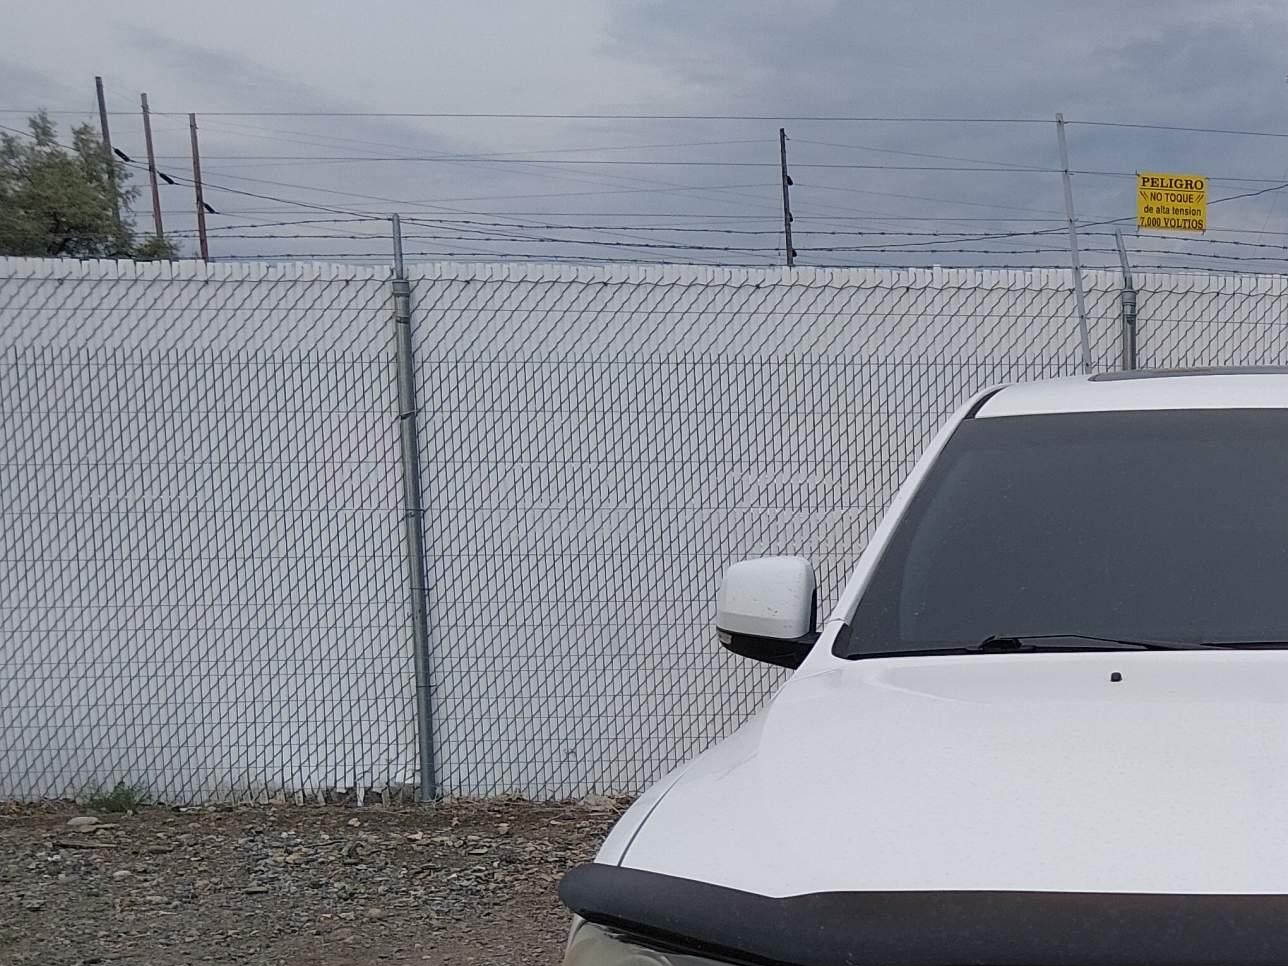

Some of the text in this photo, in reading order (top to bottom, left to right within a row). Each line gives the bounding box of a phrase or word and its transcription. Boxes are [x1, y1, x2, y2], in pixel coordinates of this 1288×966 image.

[1142, 177, 1204, 190] PELIGRO
[1150, 192, 1194, 203] NO TOQUE
[1143, 205, 1202, 216] de alta tension
[1163, 218, 1204, 230] VOLTIOS
